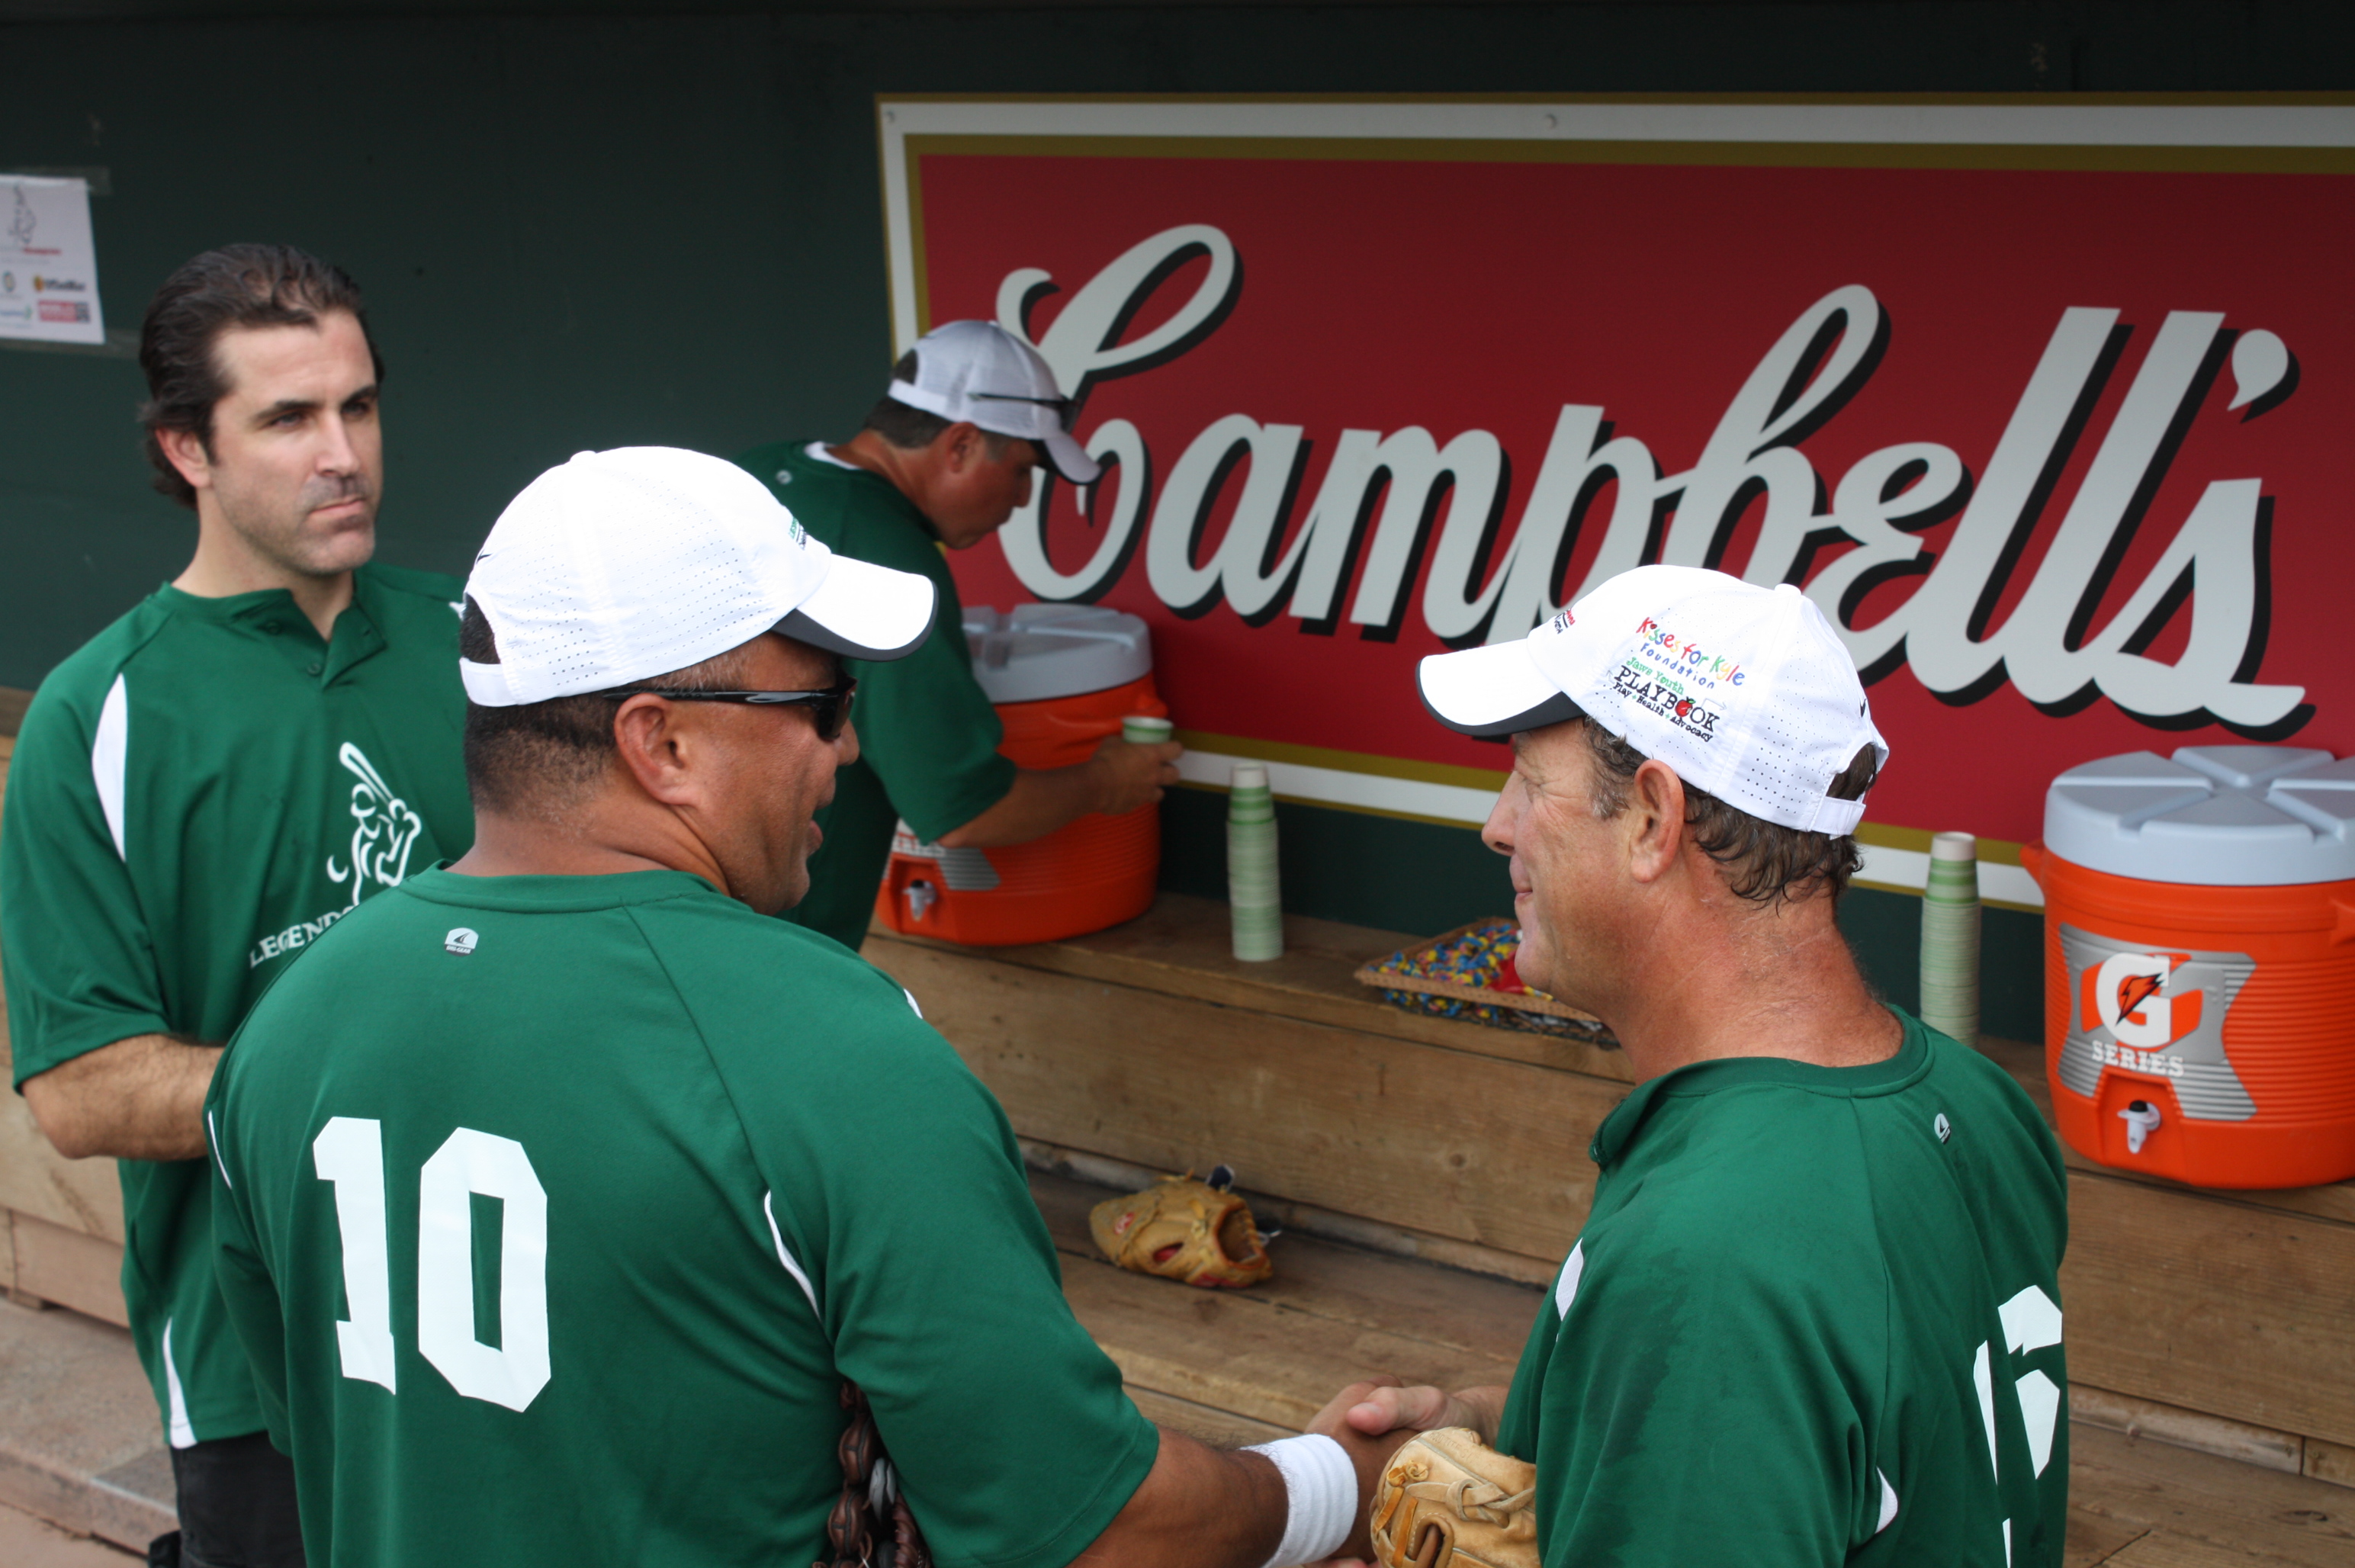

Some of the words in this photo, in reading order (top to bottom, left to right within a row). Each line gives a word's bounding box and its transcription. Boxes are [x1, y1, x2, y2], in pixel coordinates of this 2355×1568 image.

[994, 222, 2305, 727] Campbell's
[1626, 657, 1653, 676] Jaws
[1653, 670, 1685, 696] Youth
[1636, 617, 1681, 653] Kisses
[1681, 643, 1709, 667] for
[1709, 655, 1745, 686] Kyle
[1640, 642, 1715, 689] Foundation
[1612, 682, 1632, 698] Play
[1636, 696, 1665, 716] Health
[1670, 715, 1714, 742] Advocacy
[249, 905, 355, 969] LEGEND
[2096, 952, 2171, 1048] G
[2091, 1039, 2184, 1077] SERIES
[313, 1116, 551, 1413] 10
